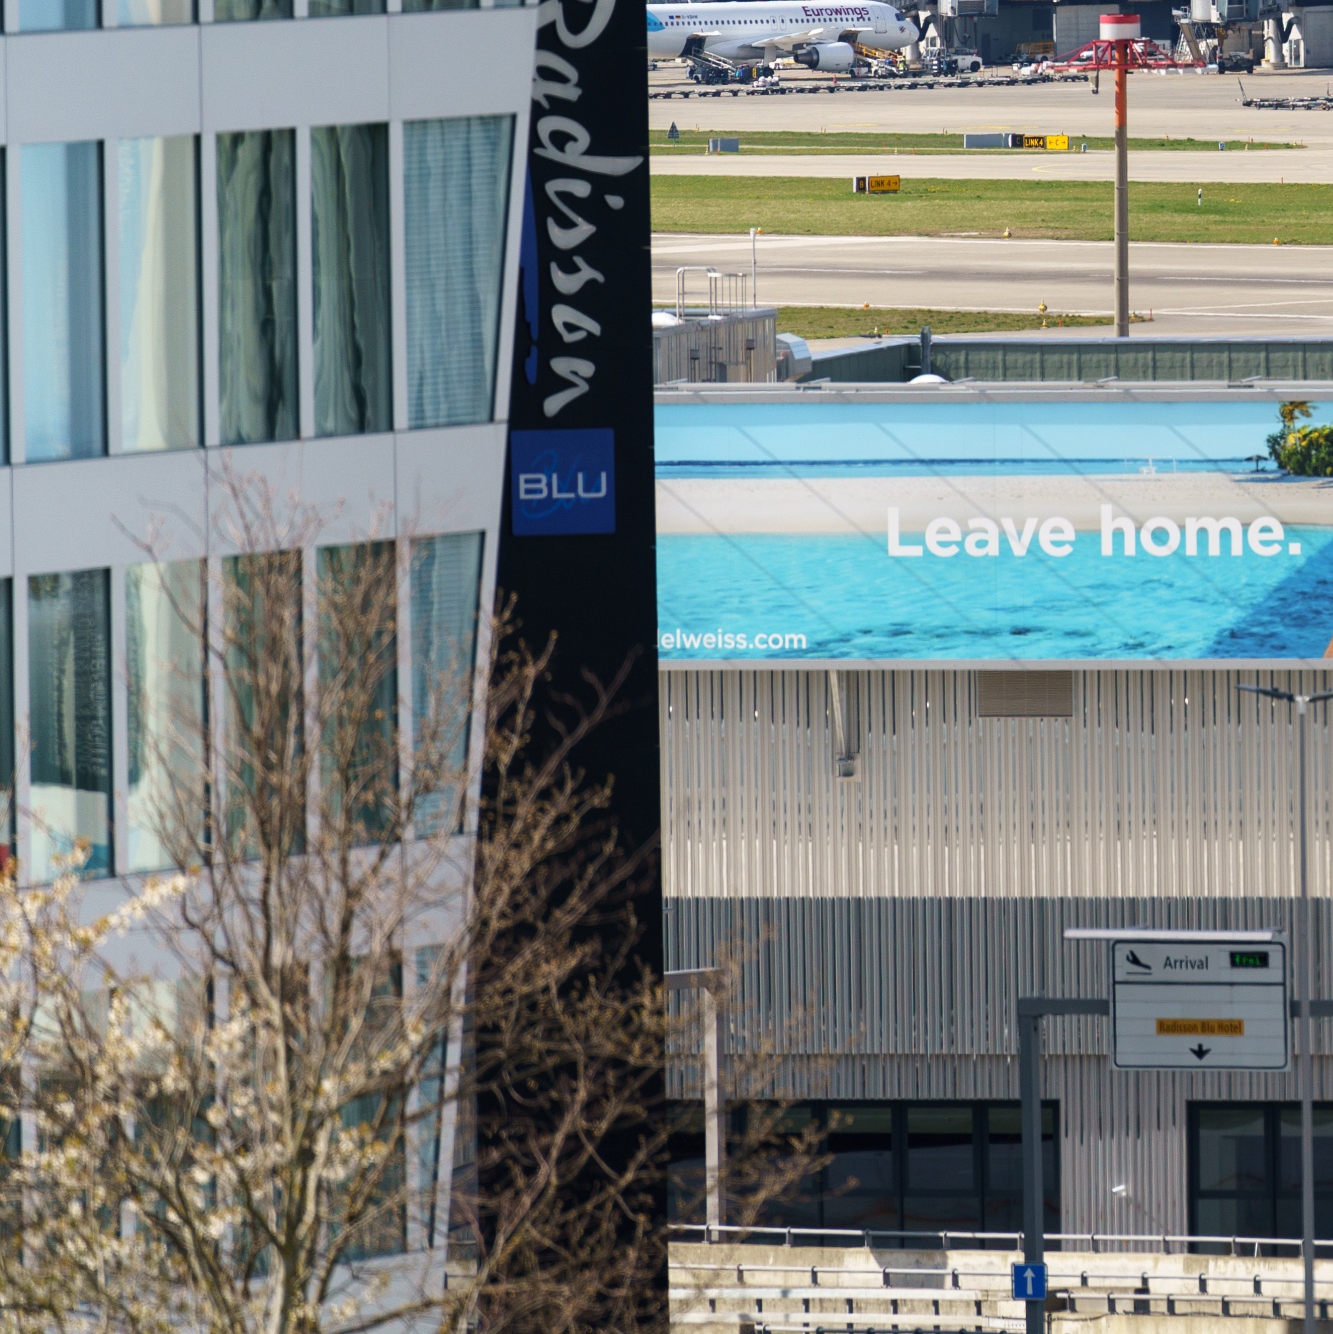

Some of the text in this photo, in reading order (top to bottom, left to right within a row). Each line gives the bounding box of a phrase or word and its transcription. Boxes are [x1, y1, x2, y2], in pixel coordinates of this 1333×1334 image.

[801, 5, 870, 20] Eurowings
[870, 180, 885, 188] LINK
[518, 471, 607, 500] BLU
[886, 503, 1302, 558] Leave home.
[1163, 955, 1209, 970] Arrival
[1159, 1021, 1242, 1033] Radisson Blu Hotel
